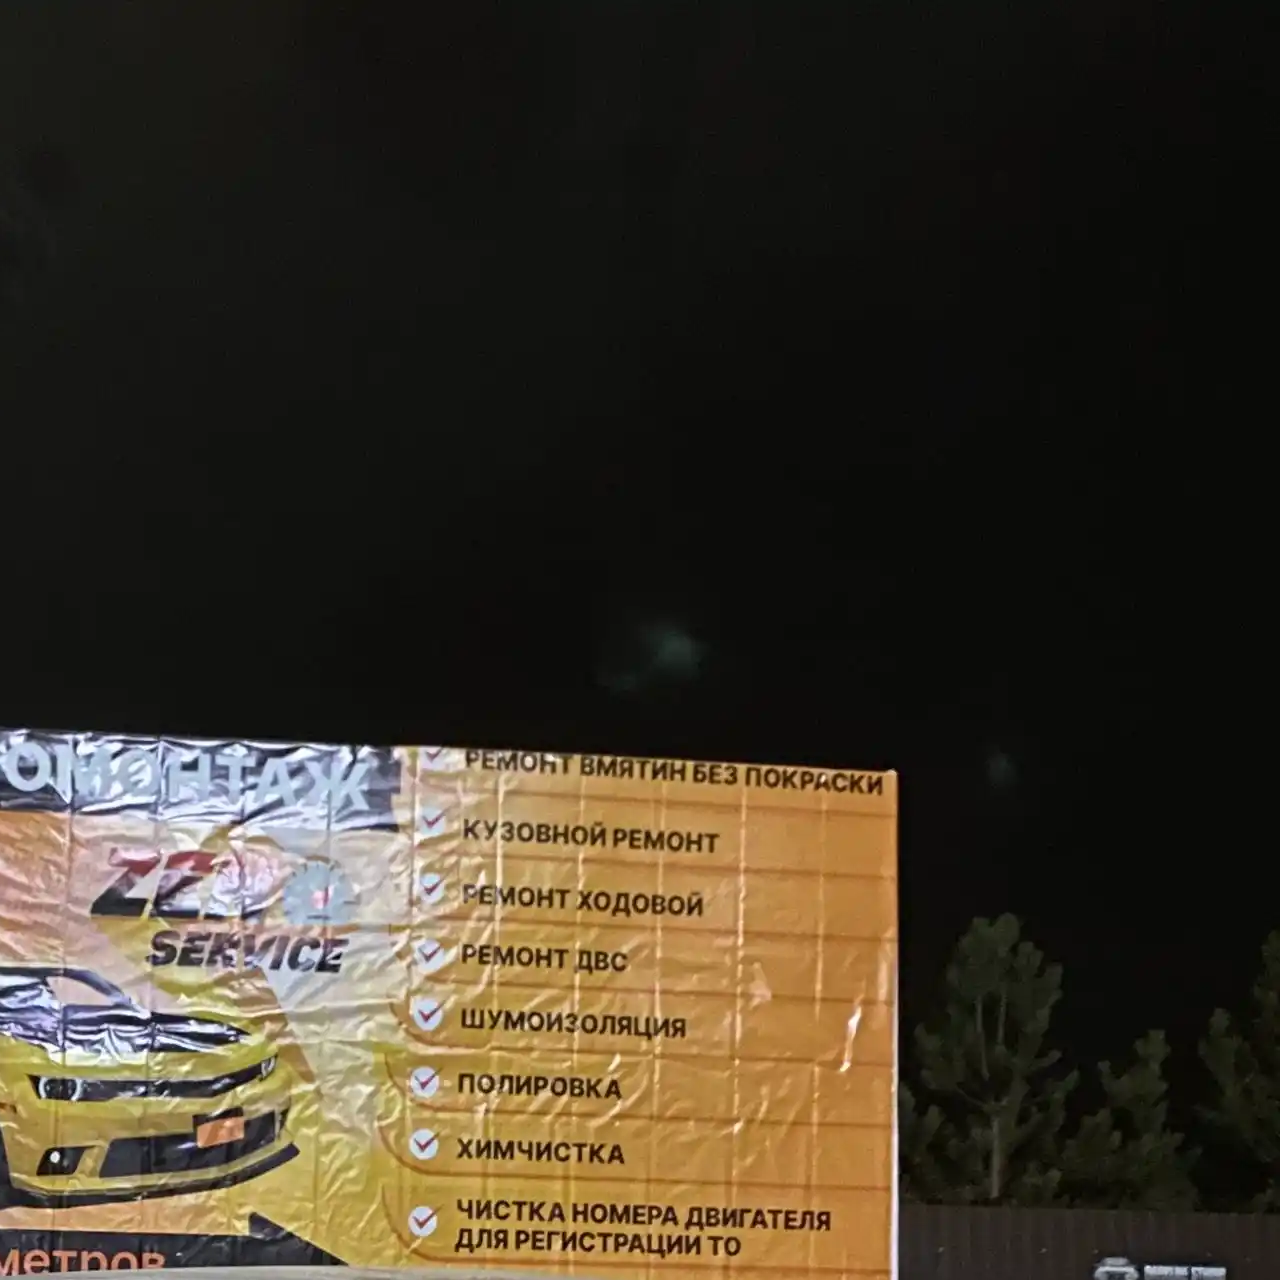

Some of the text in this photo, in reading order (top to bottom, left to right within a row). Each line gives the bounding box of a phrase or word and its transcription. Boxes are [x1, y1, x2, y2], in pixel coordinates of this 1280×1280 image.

[465, 751, 883, 796] РЕМОНТ ВМЯТИН БЕЗ ПОКРАСКИ
[463, 818, 720, 854] КУЗОВНОЙ РЕМОНТ
[463, 884, 704, 917] РЕМОНТ ХОДОВОЙ
[145, 930, 350, 974] SERVICE
[461, 945, 629, 973] РЕМОНТ ДВС
[460, 1010, 687, 1039] ШУМОИЗОЛЯЦИЯ
[457, 1073, 621, 1100] ПОЛИРОВКА
[457, 1138, 625, 1165] ХИМЧИСТКА
[457, 1200, 831, 1232] ЧИСТКА НОМЕРА ДВИГАТЕЛЯ
[454, 1228, 742, 1258] ДЛЯ РЕГИСТРАЦИИ ТО
